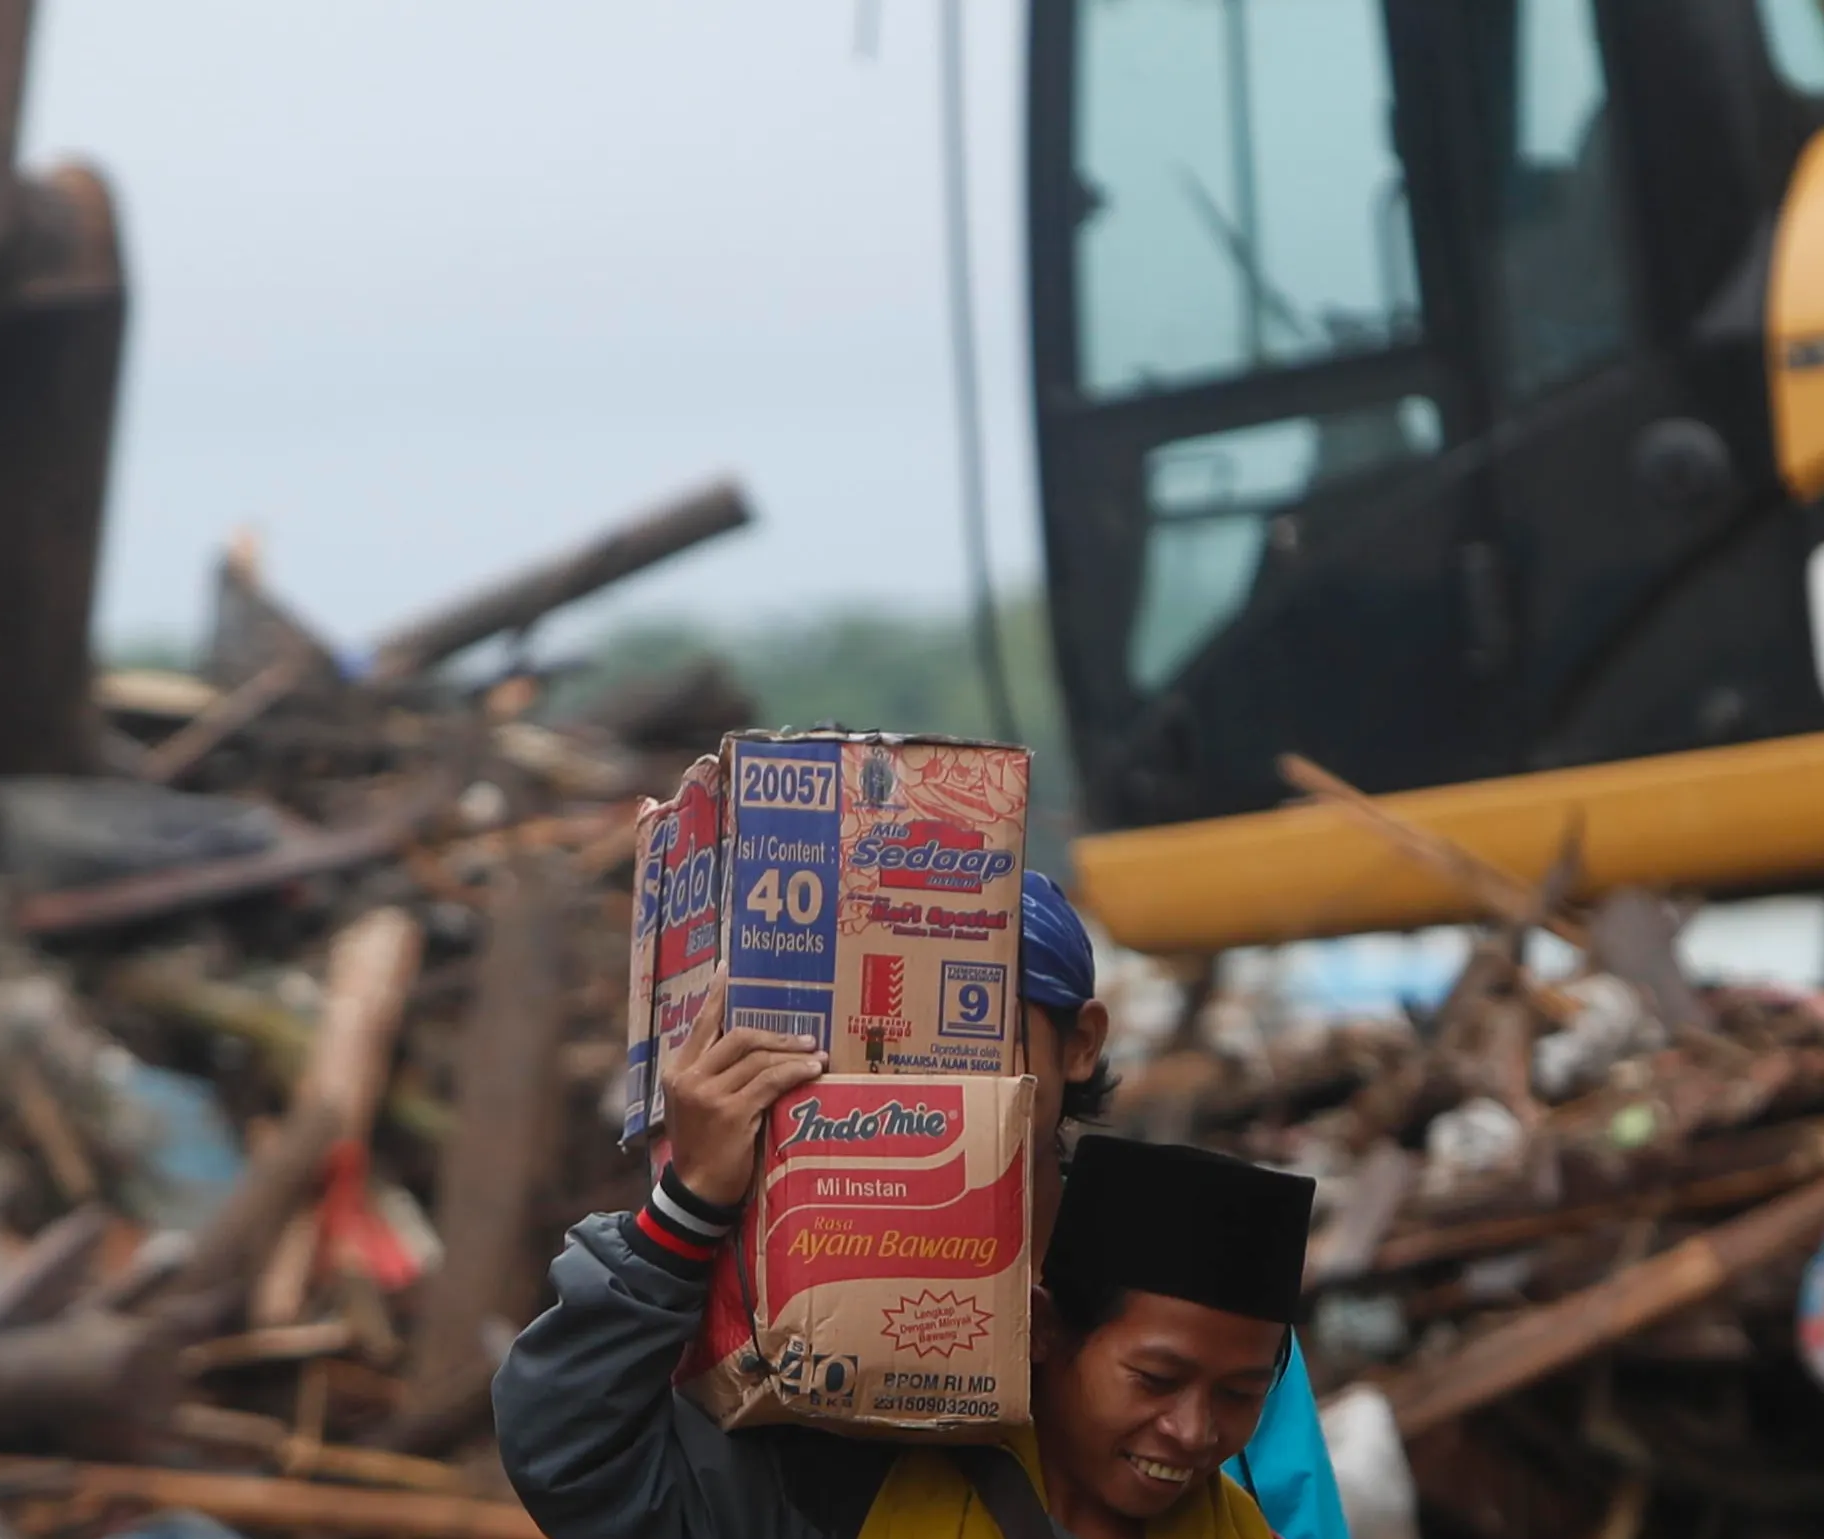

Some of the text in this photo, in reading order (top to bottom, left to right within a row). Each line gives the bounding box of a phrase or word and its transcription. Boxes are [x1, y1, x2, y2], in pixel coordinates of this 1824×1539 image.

[743, 762, 833, 805] 20057
[870, 822, 910, 839] Mie
[738, 836, 755, 860] Isi
[768, 836, 825, 864] Content
[849, 837, 1015, 884] Sedaap
[747, 868, 824, 925] 40
[741, 925, 825, 956] bks/packs
[958, 983, 989, 1022] 9
[887, 1054, 938, 1068] PRAKARSA
[940, 1056, 969, 1070] ALAM
[970, 1057, 1001, 1072] SEGAR
[816, 1178, 907, 1197] Mi Instan
[814, 1216, 853, 1230] Rasa
[787, 1229, 998, 1267] Ayam Bawang
[778, 1354, 857, 1395] 40
[883, 1373, 996, 1393] BPOM RI MD
